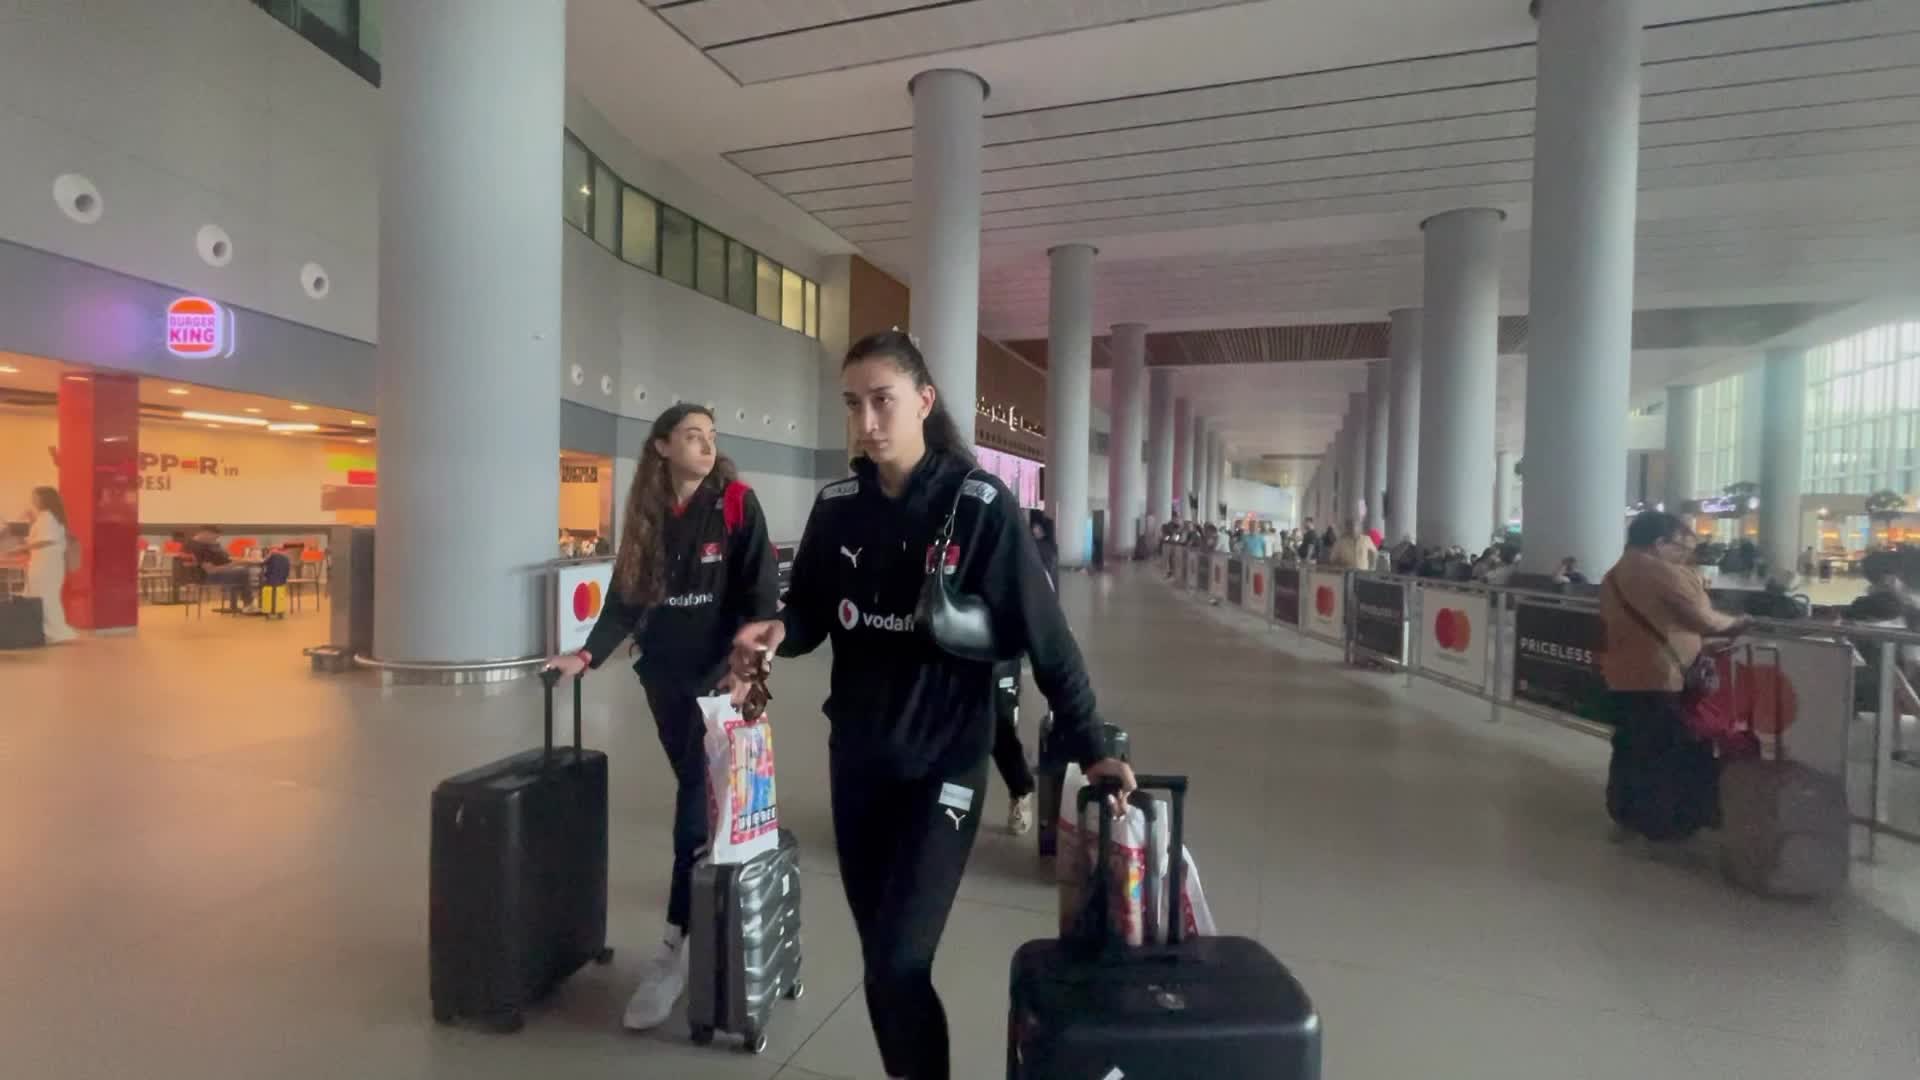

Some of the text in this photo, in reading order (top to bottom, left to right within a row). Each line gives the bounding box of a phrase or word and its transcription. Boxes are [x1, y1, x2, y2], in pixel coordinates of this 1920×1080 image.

[169, 316, 216, 328] BURGER
[169, 328, 215, 343] KING
[863, 611, 915, 633] vodaf
[1520, 637, 1593, 665] PRICELESS
